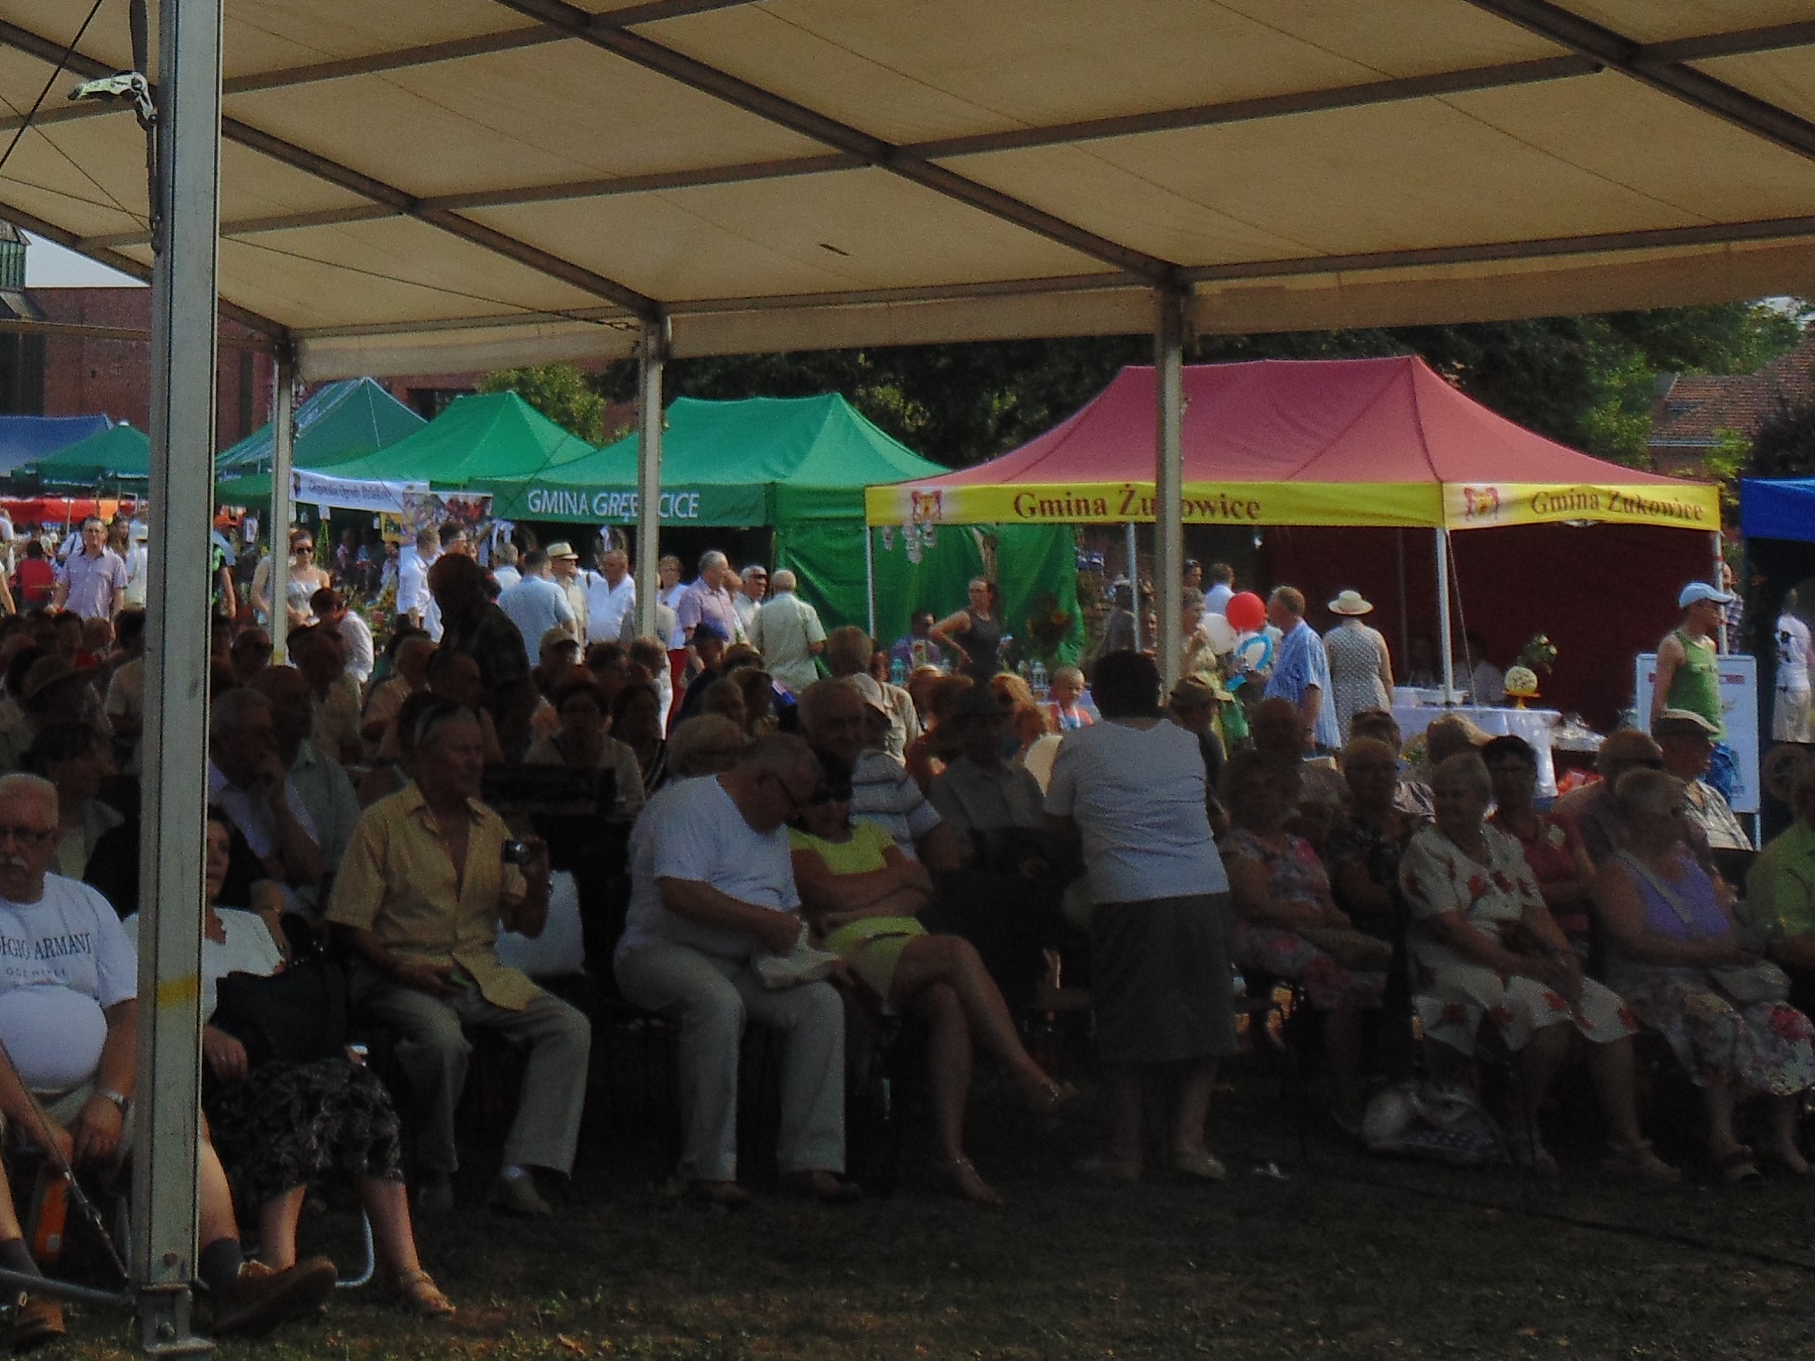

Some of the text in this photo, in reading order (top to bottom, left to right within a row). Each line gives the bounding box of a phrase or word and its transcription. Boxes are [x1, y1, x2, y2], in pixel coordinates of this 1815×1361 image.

[528, 490, 589, 516] GMINA
[1014, 483, 1261, 520] Gmina Żuowice
[1531, 488, 1600, 515] Gmina
[35, 933, 92, 960] ARMANI
